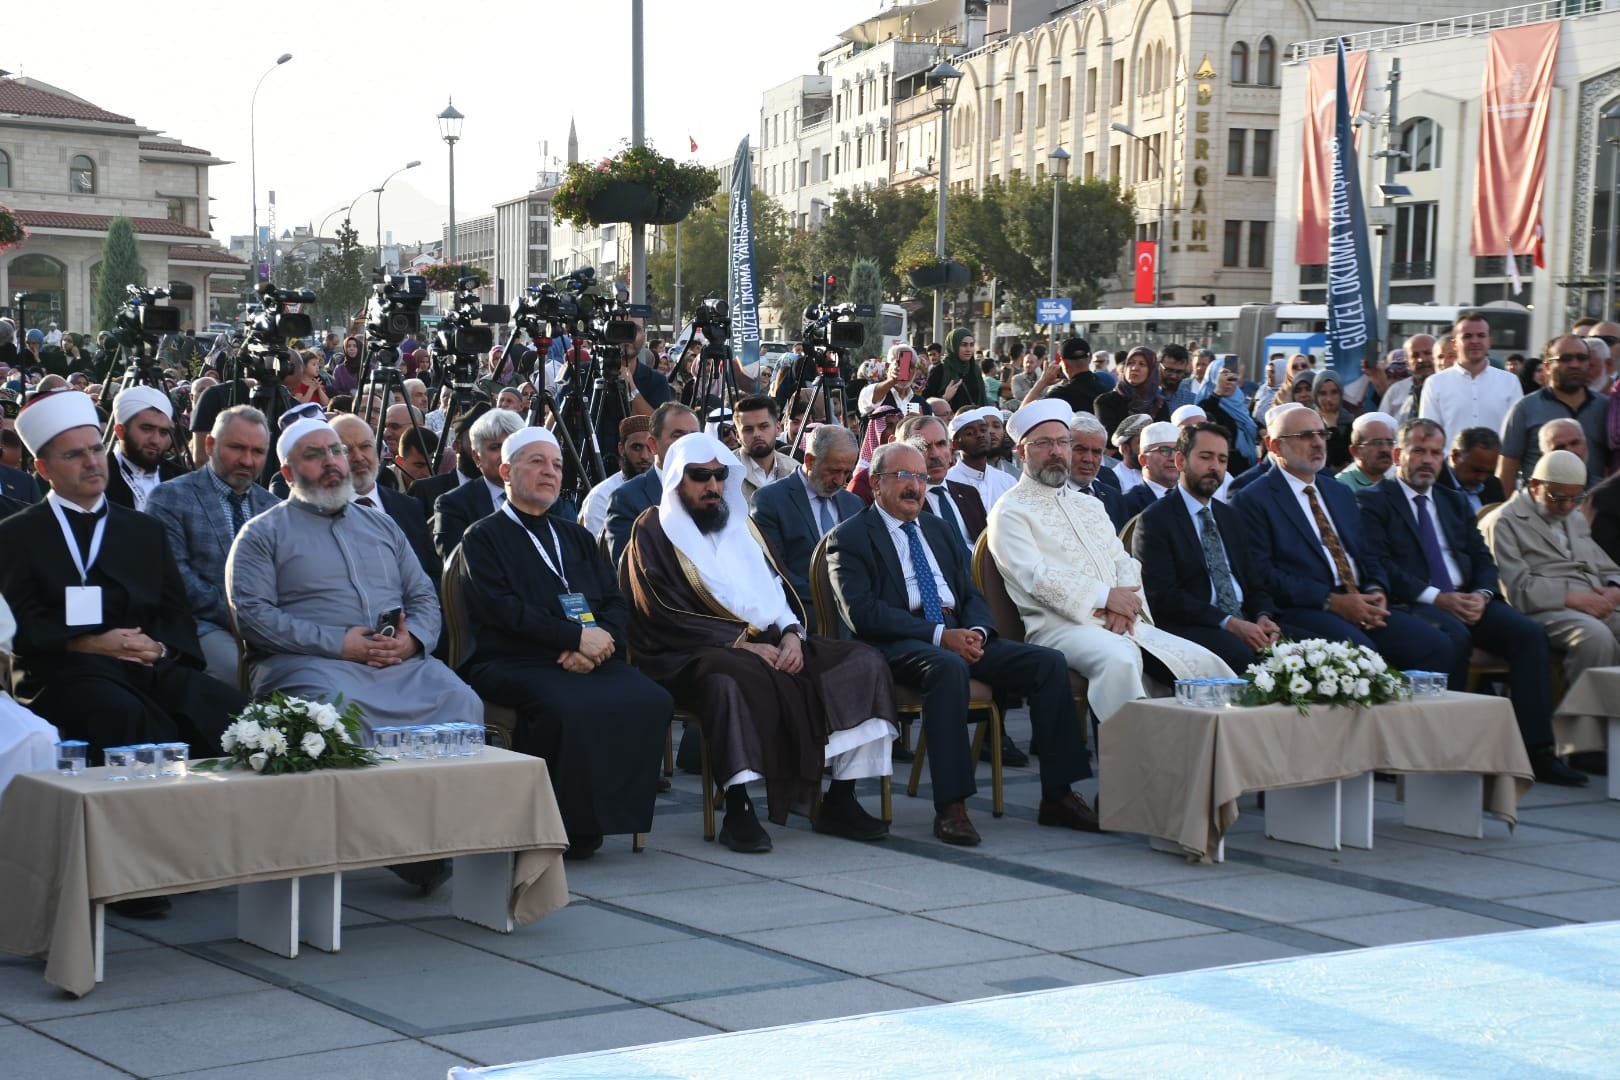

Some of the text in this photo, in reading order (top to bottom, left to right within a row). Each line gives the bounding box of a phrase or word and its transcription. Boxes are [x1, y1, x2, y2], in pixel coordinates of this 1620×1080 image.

[1190, 83, 1212, 241] DERGAH
[740, 263, 754, 304] OKUMA
[1328, 231, 1360, 295] OKUMA
[742, 307, 759, 342] GÜZEL
[1042, 301, 1057, 309] WC
[1332, 294, 1367, 350] GÜZEL
